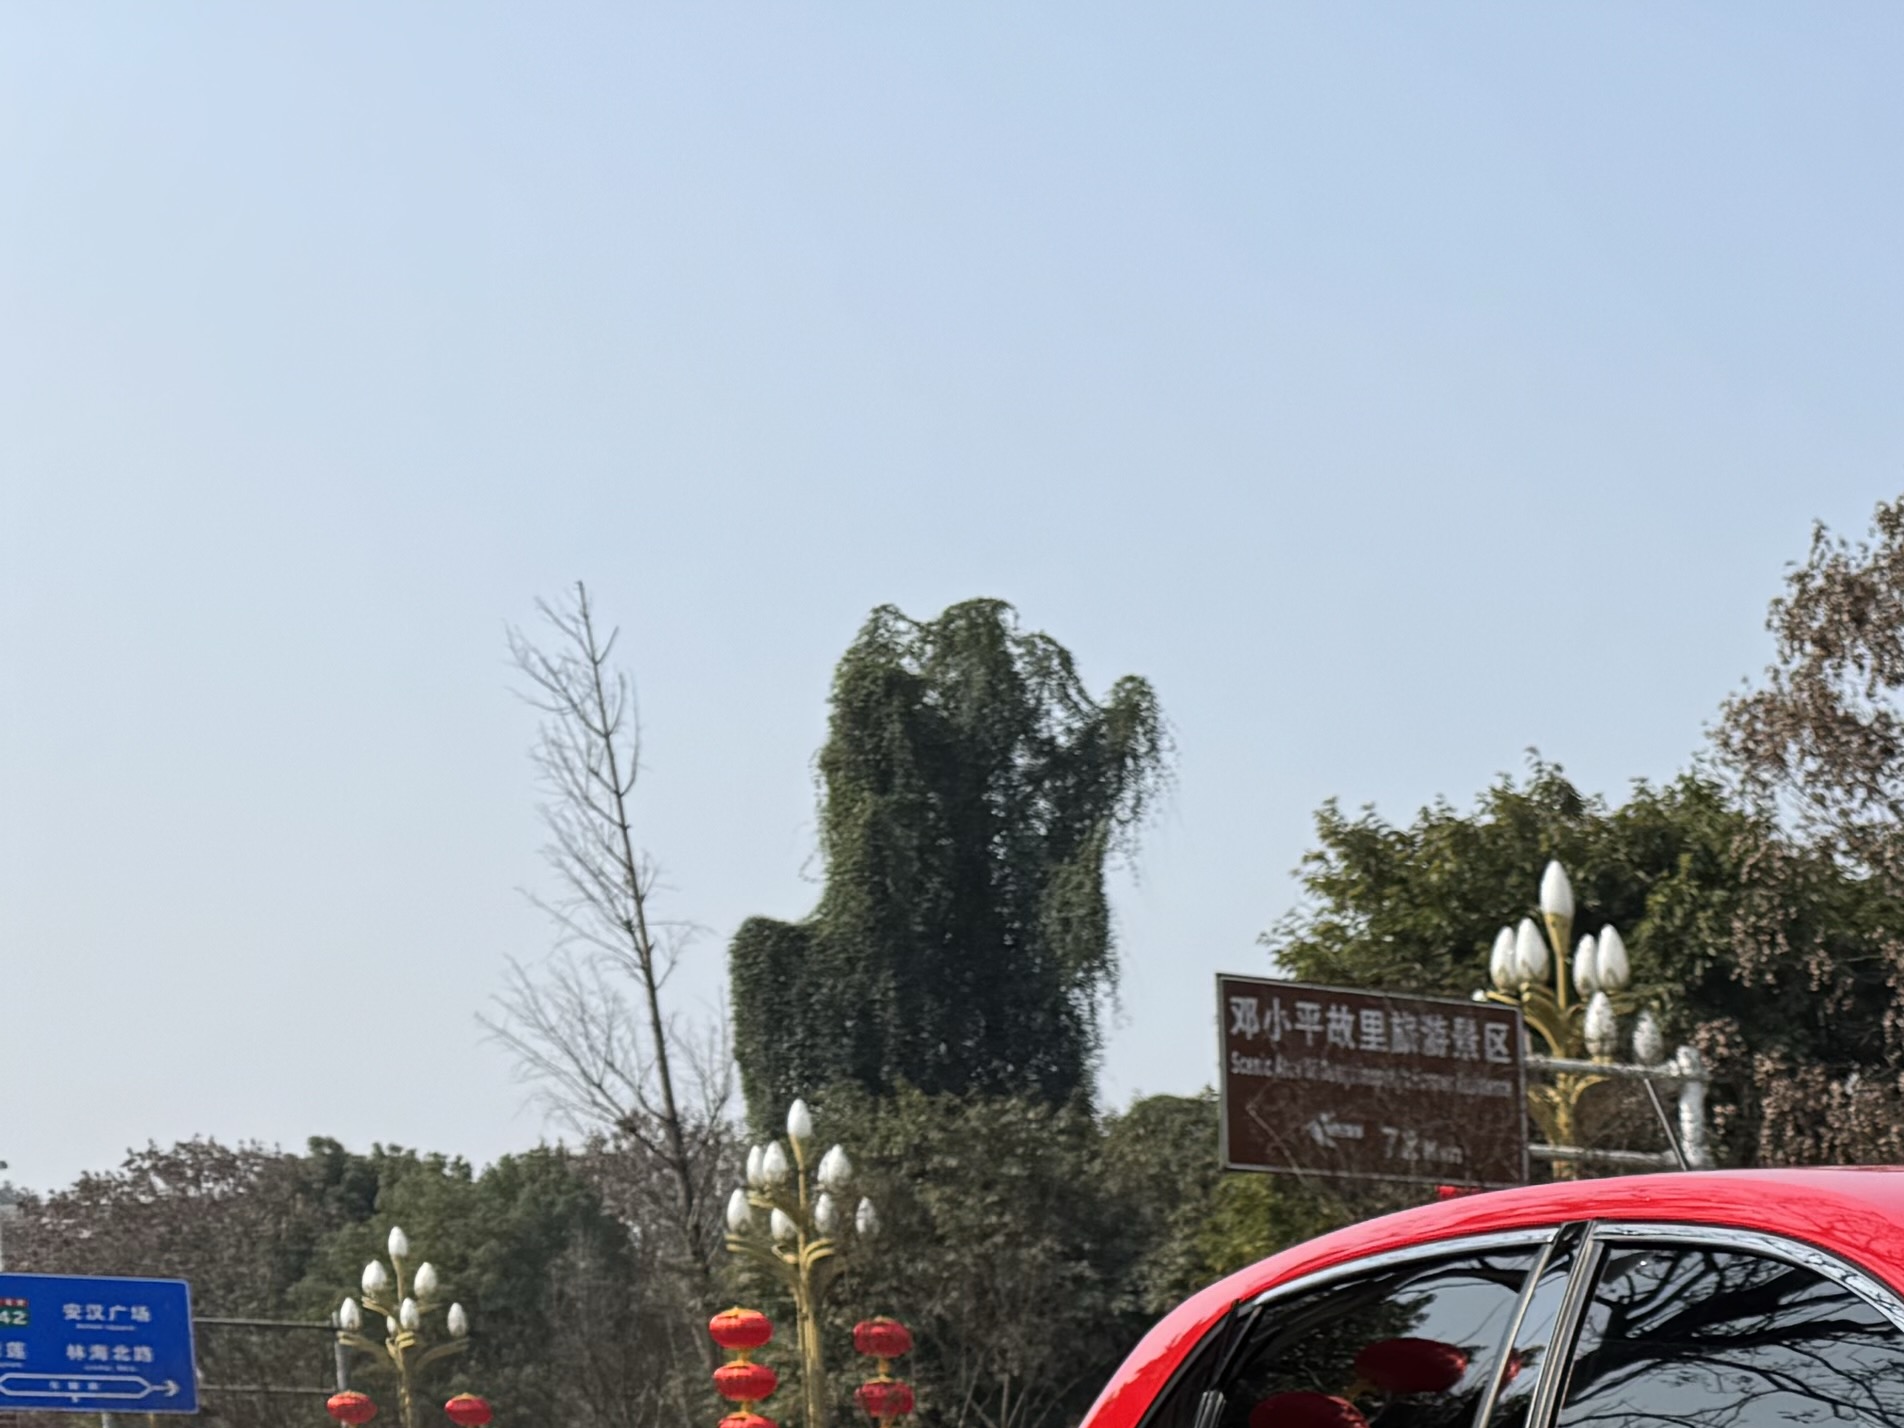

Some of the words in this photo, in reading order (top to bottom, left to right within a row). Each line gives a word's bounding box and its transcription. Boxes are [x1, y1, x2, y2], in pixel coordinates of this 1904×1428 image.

[1228, 996, 1512, 1064] 邓小平故里旅游景区
[62, 1303, 151, 1323] 安汉广场
